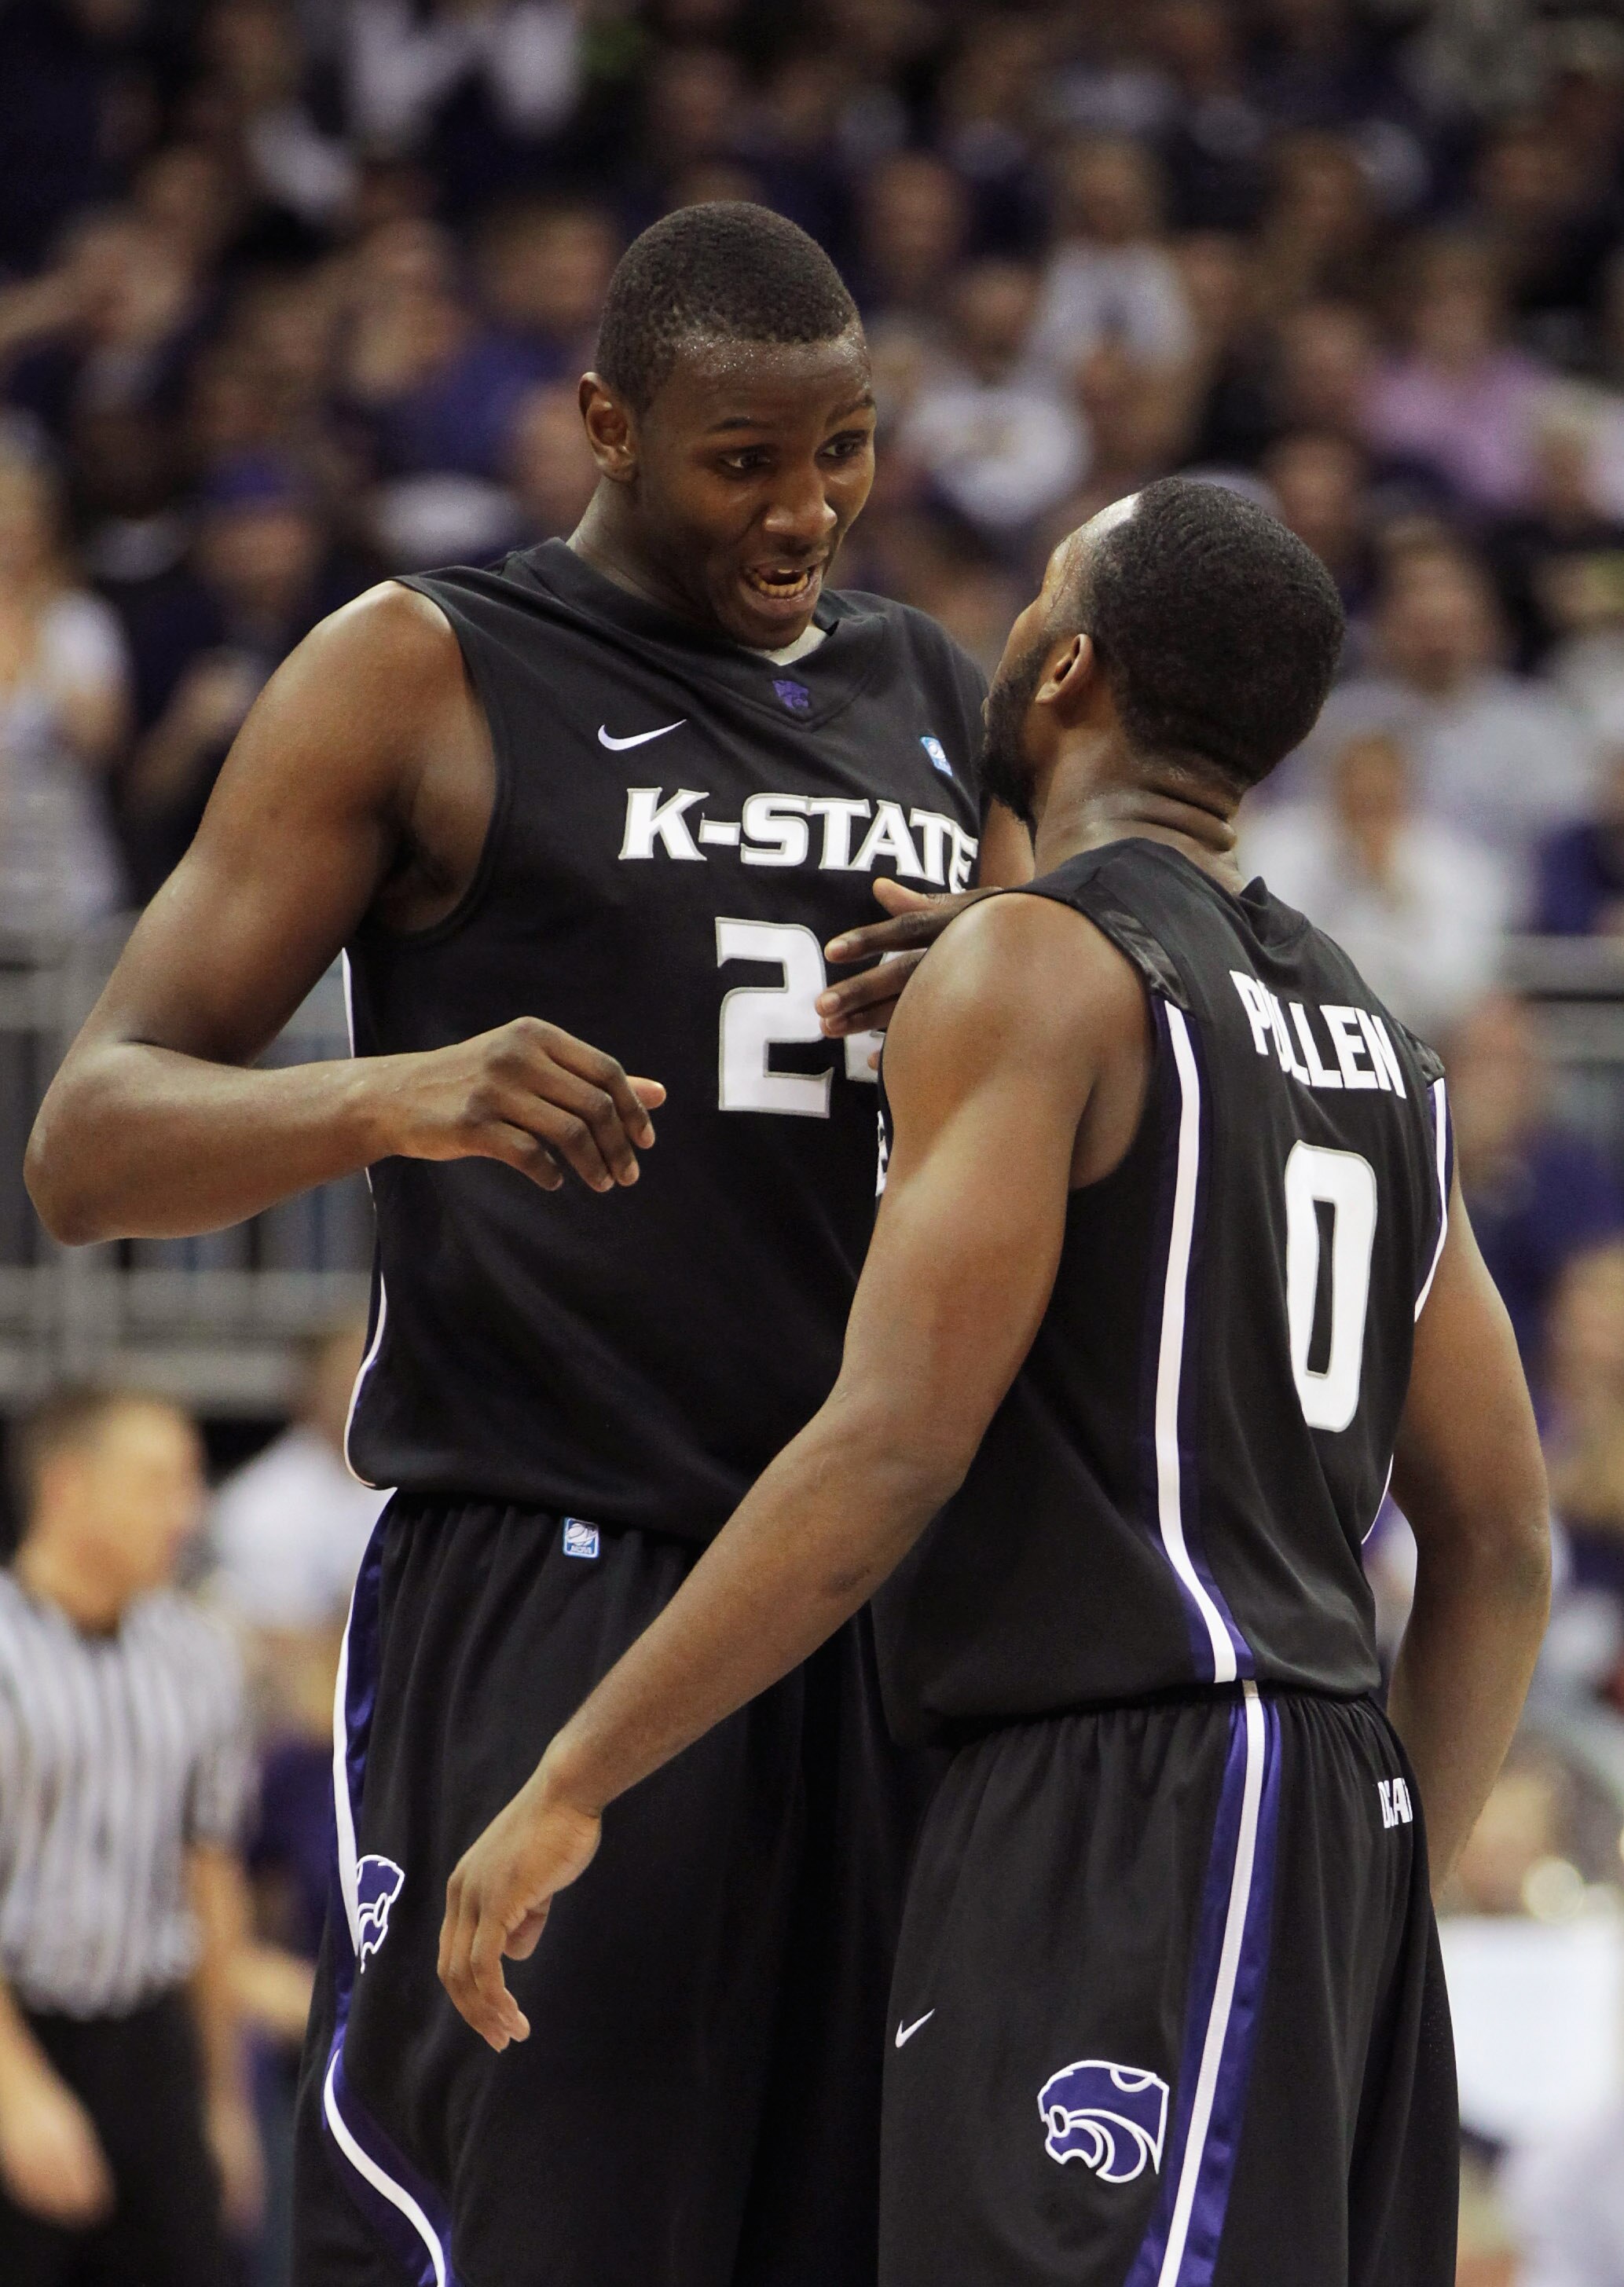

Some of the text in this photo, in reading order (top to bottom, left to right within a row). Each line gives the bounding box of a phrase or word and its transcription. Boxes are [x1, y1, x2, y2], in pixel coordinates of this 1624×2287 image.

[619, 786, 979, 894] K-STATE
[1229, 969, 1407, 1099] PULLEN
[1285, 1139, 1377, 1432] 0
